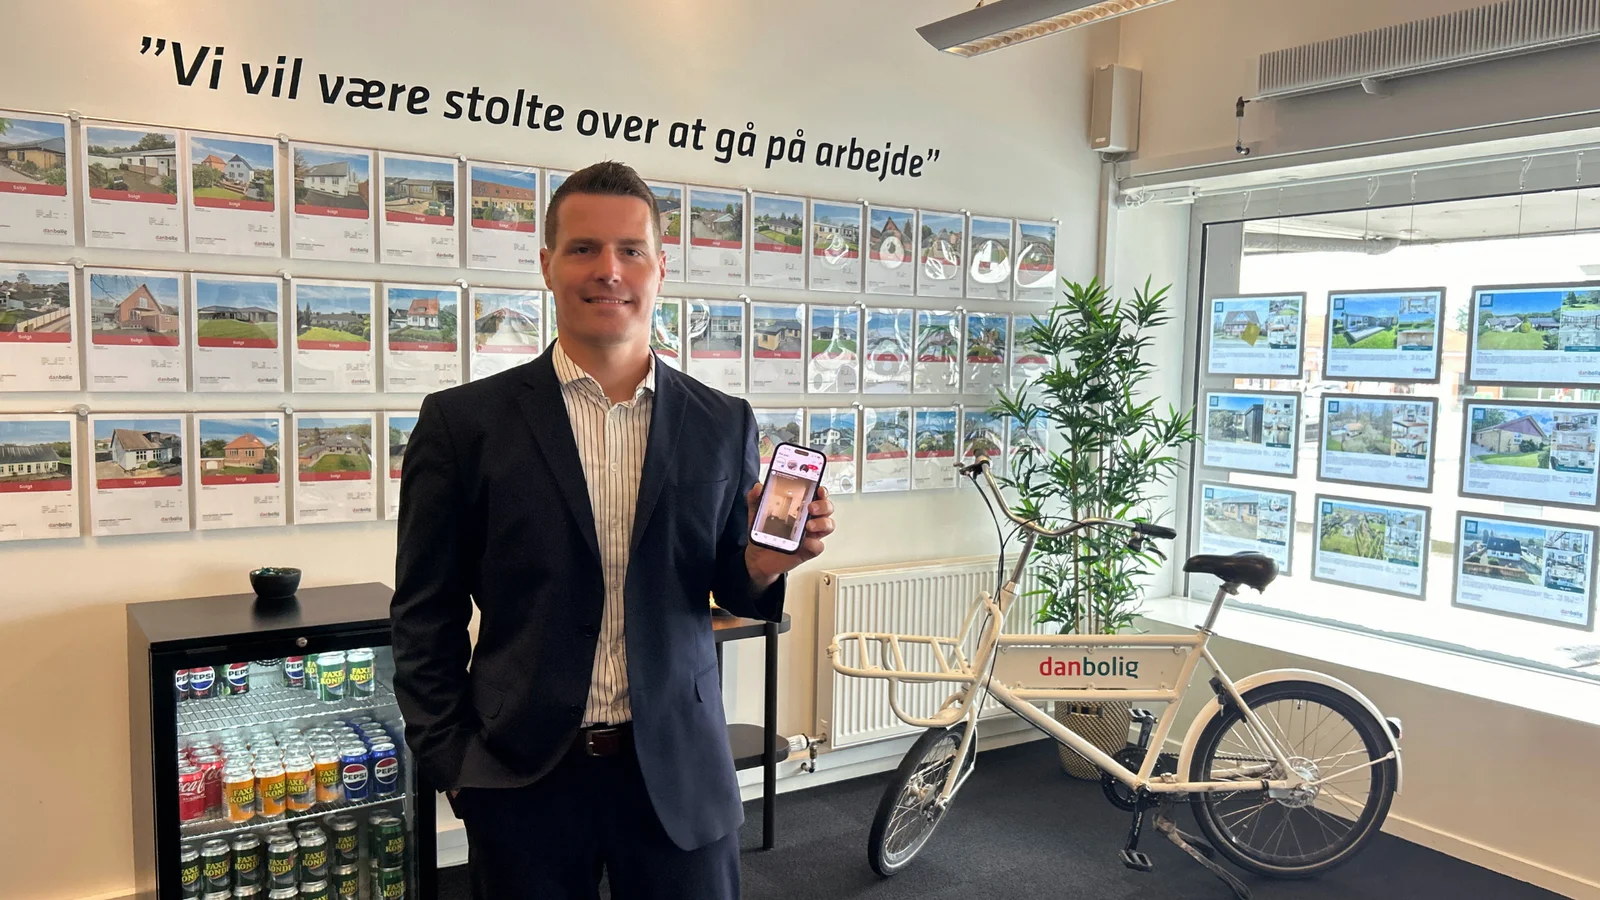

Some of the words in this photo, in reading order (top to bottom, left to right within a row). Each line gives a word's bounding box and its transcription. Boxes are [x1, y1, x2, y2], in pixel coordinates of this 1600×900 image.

[242, 56, 302, 99] vil
[319, 74, 429, 114] være
[444, 87, 564, 131] stolte
[577, 110, 659, 143] over
[669, 118, 706, 150] at
[715, 121, 756, 164] gå
[765, 127, 805, 169] på
[1040, 656, 1138, 679] danbolig
[344, 772, 367, 780] PEPSI
[205, 861, 227, 870] FAXE
